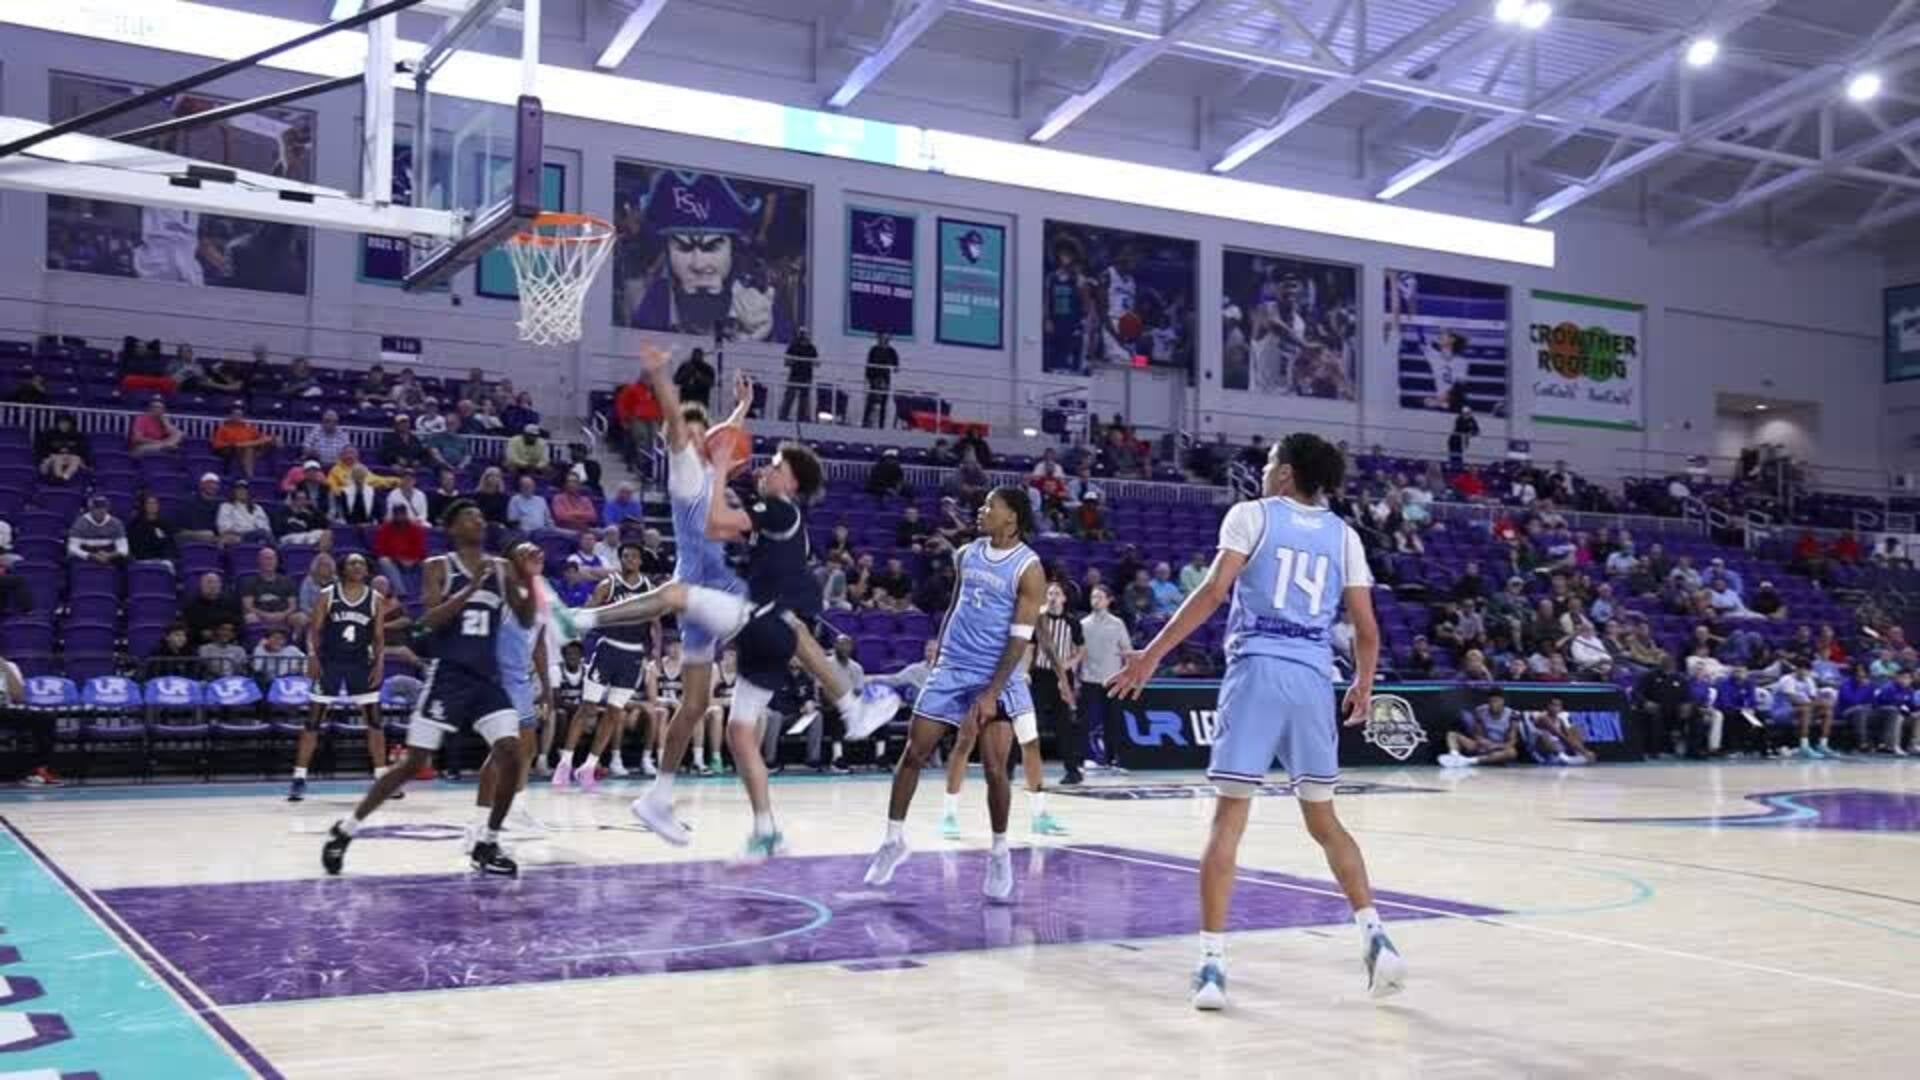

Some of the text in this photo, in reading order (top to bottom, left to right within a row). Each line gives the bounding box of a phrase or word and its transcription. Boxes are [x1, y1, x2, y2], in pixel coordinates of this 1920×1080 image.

[672, 187, 710, 219] FSW
[1529, 322, 1637, 358] CROWTHER
[1538, 349, 1627, 380] ROOFING
[1273, 547, 1329, 616] 14
[341, 624, 356, 642] 4
[461, 609, 490, 636] 21
[1123, 709, 1188, 746] UR
